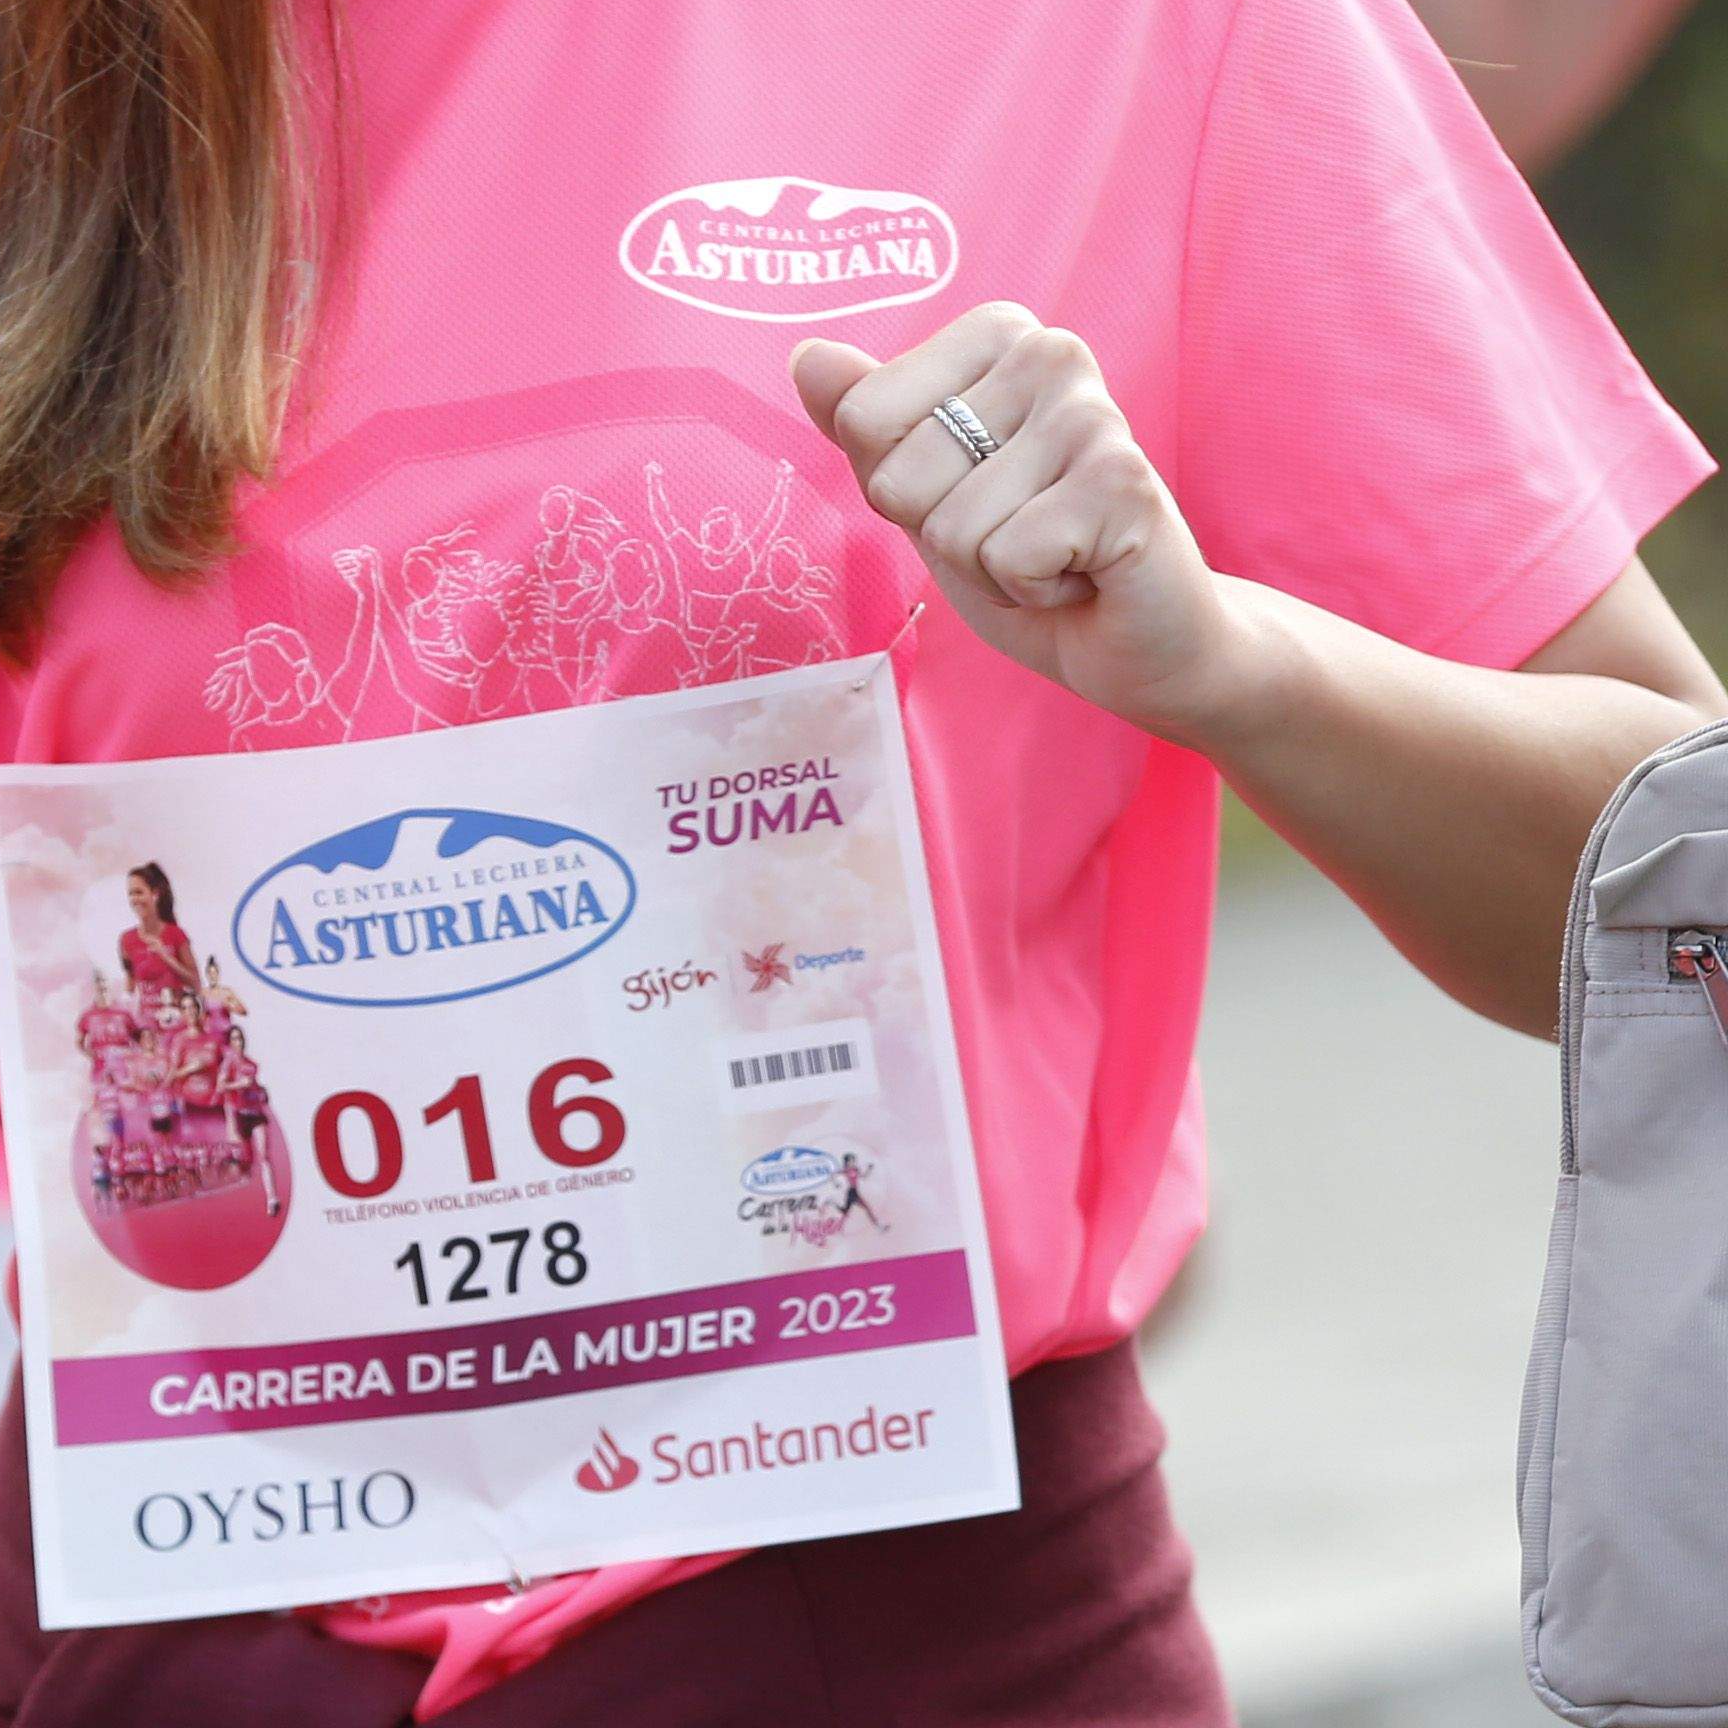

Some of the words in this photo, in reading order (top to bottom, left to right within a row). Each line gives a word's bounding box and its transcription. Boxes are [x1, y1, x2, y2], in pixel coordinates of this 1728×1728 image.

[646, 218, 938, 285] ASTURIANA
[698, 219, 809, 243] CENTRAL
[819, 215, 930, 243] LECHERA
[656, 781, 698, 808] TU
[708, 756, 839, 800] DORSAL
[667, 787, 844, 854] SUMA
[312, 875, 442, 908] CENTRAL
[453, 852, 587, 890] LECHERA
[264, 879, 610, 969] ASTURIANA
[622, 960, 718, 1012] gijón
[794, 946, 866, 971] Deporte
[312, 1056, 627, 1199] 016
[324, 1199, 420, 1224] TELÉFONO
[423, 1187, 522, 1214] VIOLENCIA
[525, 1182, 552, 1199] DE
[555, 1167, 636, 1193] GÉNERO
[394, 1221, 589, 1306] 1278
[149, 1357, 395, 1417] CARRERA
[406, 1347, 479, 1394] DE
[492, 1335, 562, 1384] LA
[573, 1304, 757, 1372] MUJER
[778, 1283, 897, 1340] 2023
[651, 1403, 936, 1485] Santander
[133, 1469, 418, 1554] OYSHO
